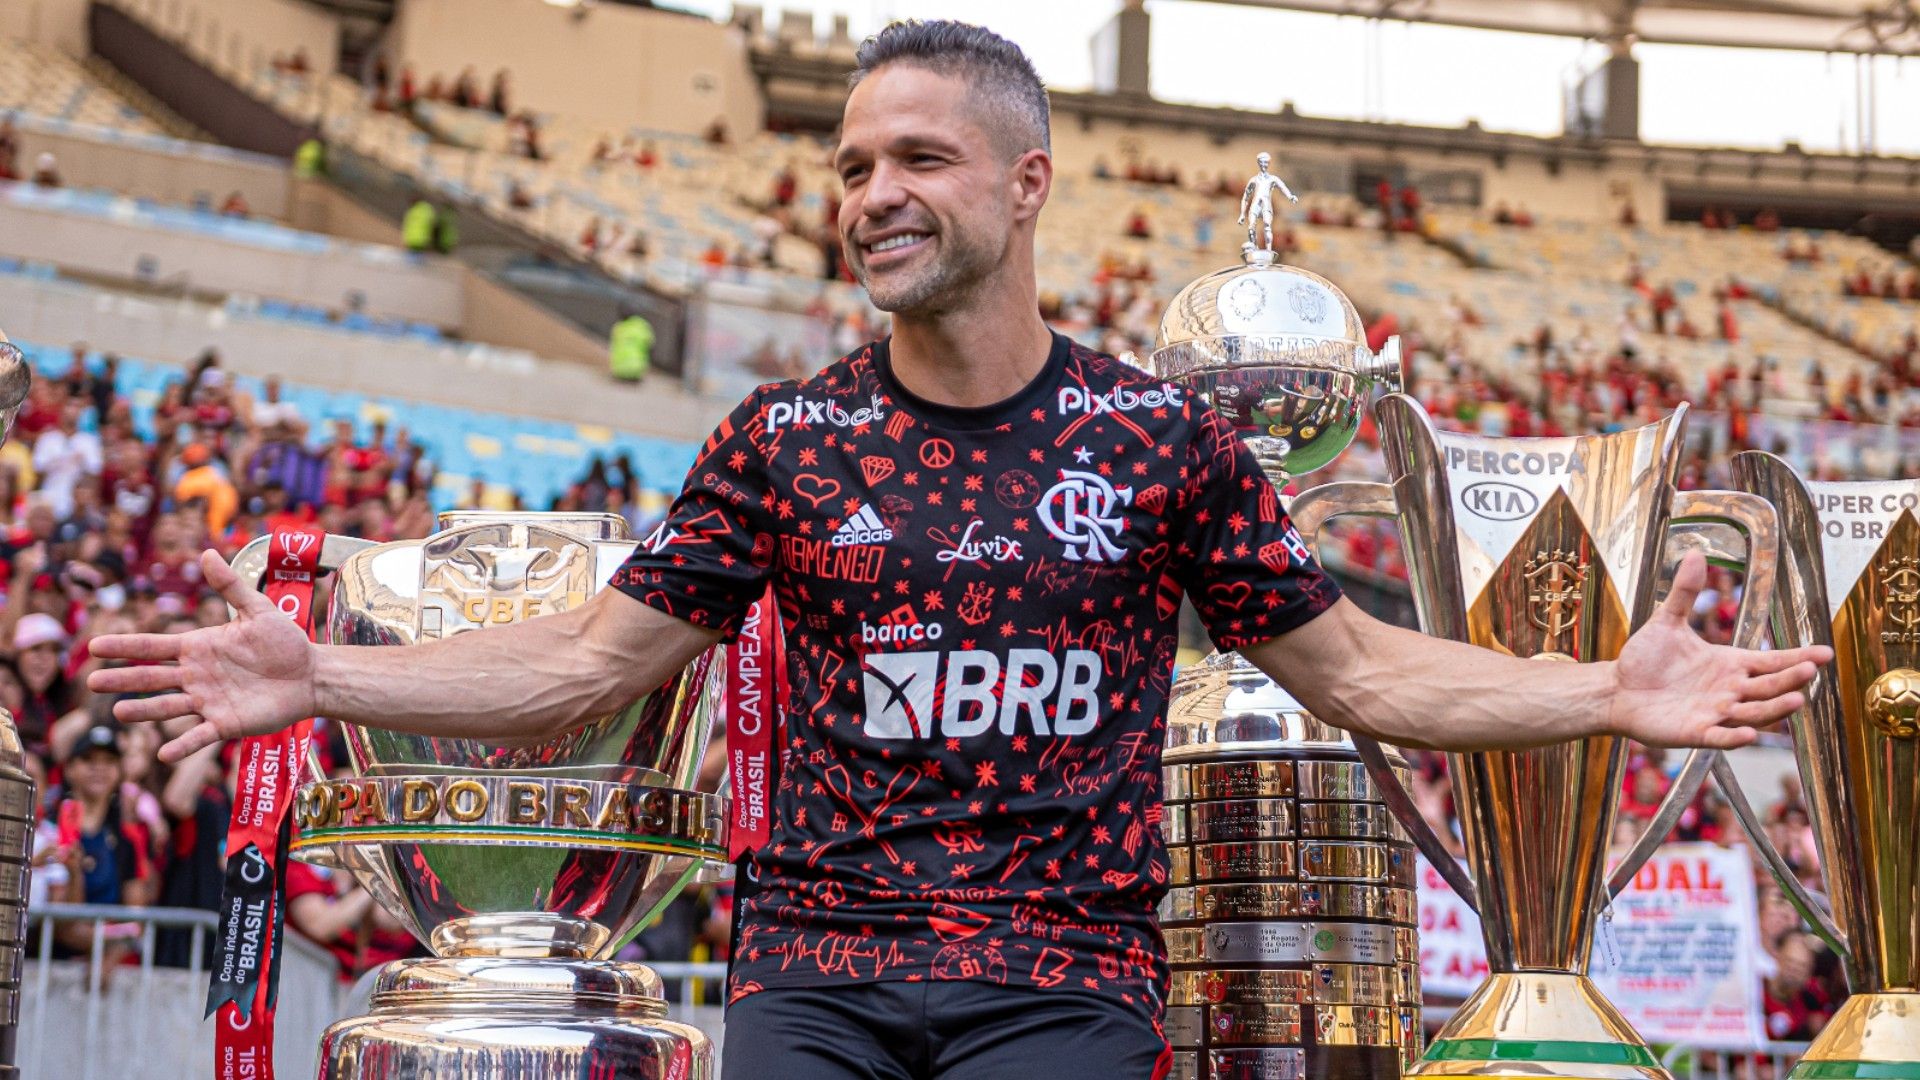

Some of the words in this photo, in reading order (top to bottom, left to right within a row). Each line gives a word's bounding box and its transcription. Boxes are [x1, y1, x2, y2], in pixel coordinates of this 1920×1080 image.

[767, 395, 885, 433] pixbet
[1059, 383, 1184, 416] pixbet
[1473, 489, 1525, 513] KIA
[832, 528, 893, 547] adidas
[936, 520, 1024, 562] Luvix
[1820, 519, 1845, 538] O
[464, 597, 543, 624] CBF
[861, 620, 943, 644] banco
[942, 649, 1102, 737] BRB
[243, 742, 261, 795] intelbras
[257, 744, 281, 813] BRASIL
[748, 751, 765, 818] BRASIL
[238, 797, 253, 825] Copa
[402, 779, 489, 822] DO
[253, 811, 264, 827] do
[749, 817, 757, 832] do
[224, 897, 242, 952] intelbras
[239, 900, 265, 970] BRASIL
[220, 952, 234, 982] Copa
[235, 969, 246, 984] do
